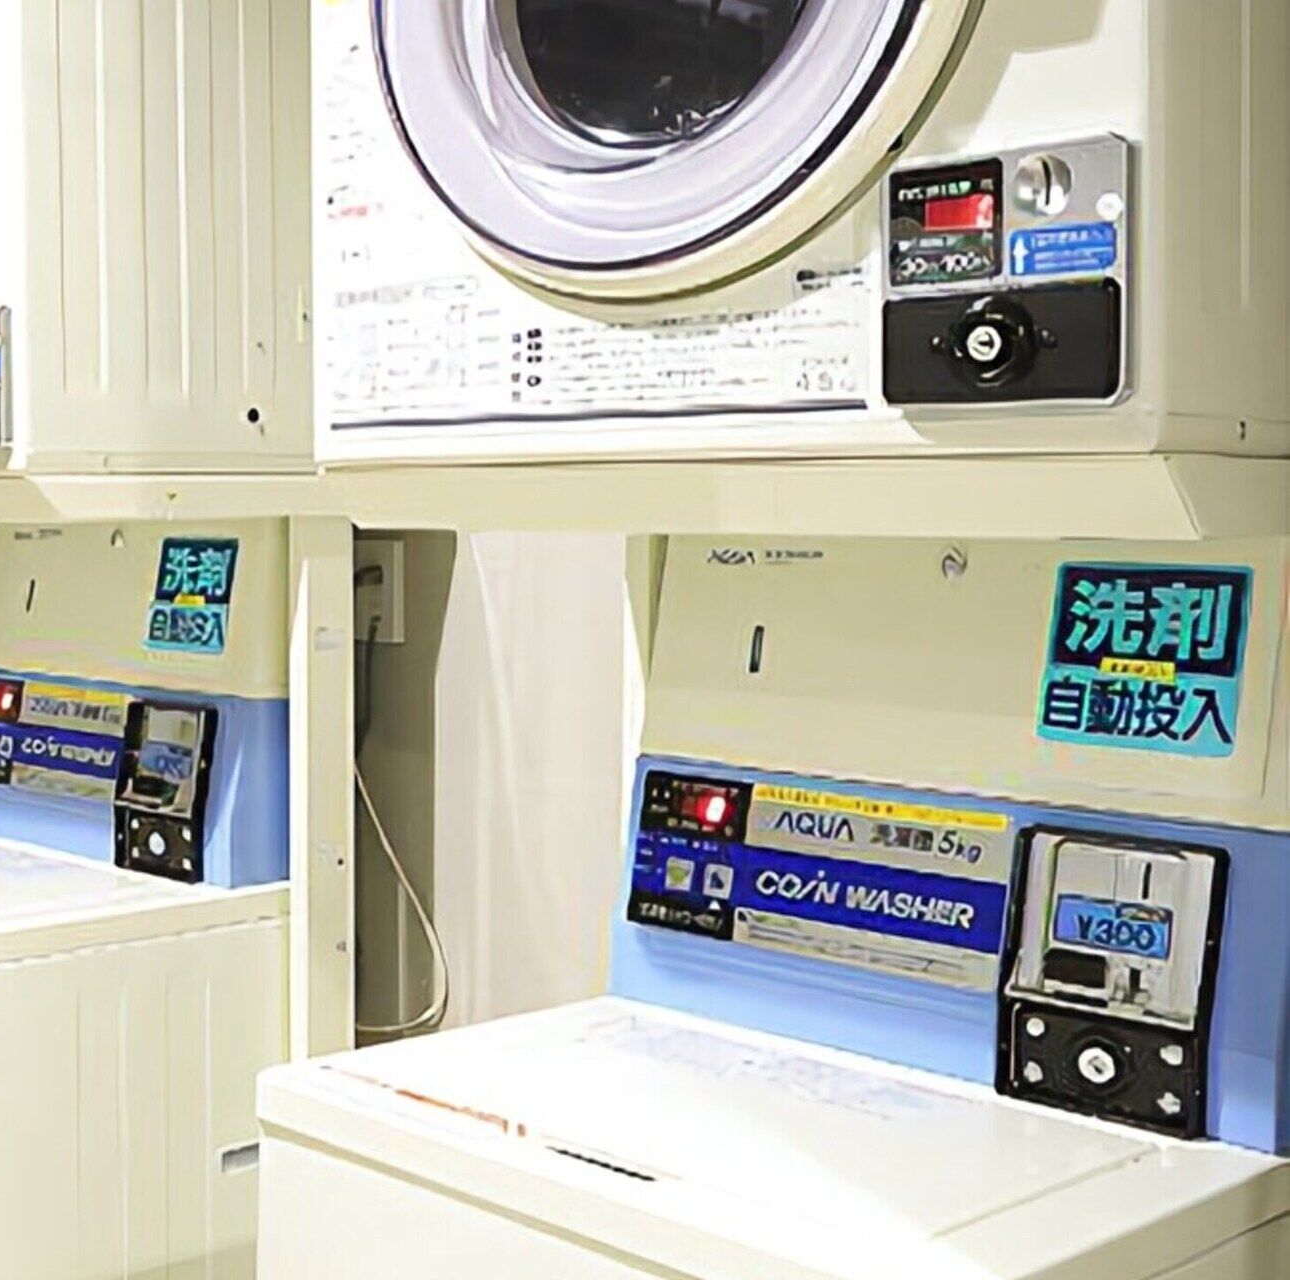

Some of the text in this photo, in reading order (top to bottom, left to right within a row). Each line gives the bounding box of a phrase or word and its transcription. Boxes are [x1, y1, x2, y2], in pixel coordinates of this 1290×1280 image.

[1064, 578, 1233, 660] 洗剤
[1042, 673, 1233, 744] 自動投入
[775, 810, 855, 843] AQUA
[845, 884, 975, 929] WASHER
